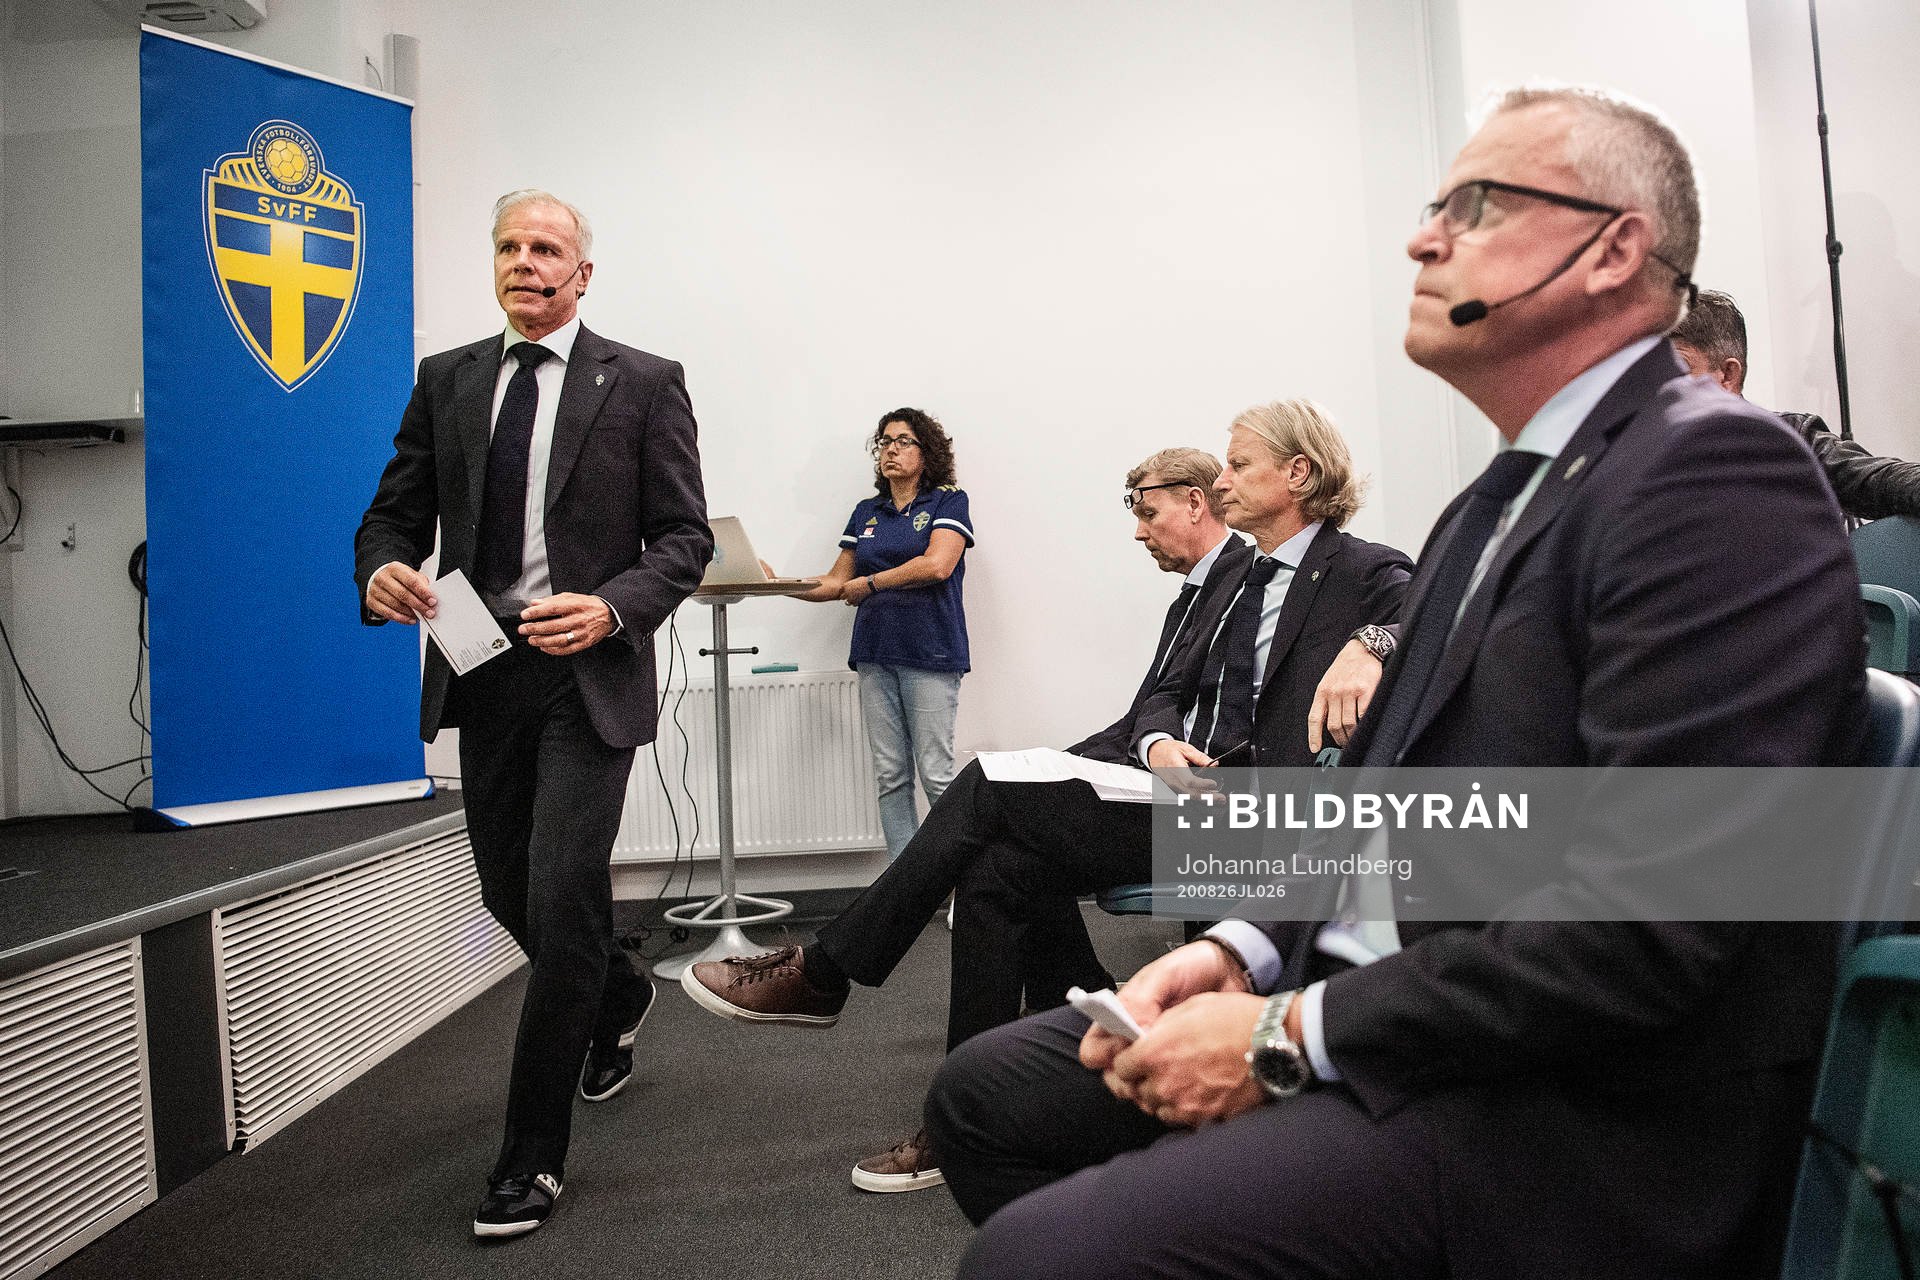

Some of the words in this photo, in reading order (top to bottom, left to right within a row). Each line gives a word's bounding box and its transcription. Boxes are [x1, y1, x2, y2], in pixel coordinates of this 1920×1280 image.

[256, 139, 271, 180] SVENSKA
[277, 182, 297, 193] 1904
[257, 196, 318, 223] SvFF
